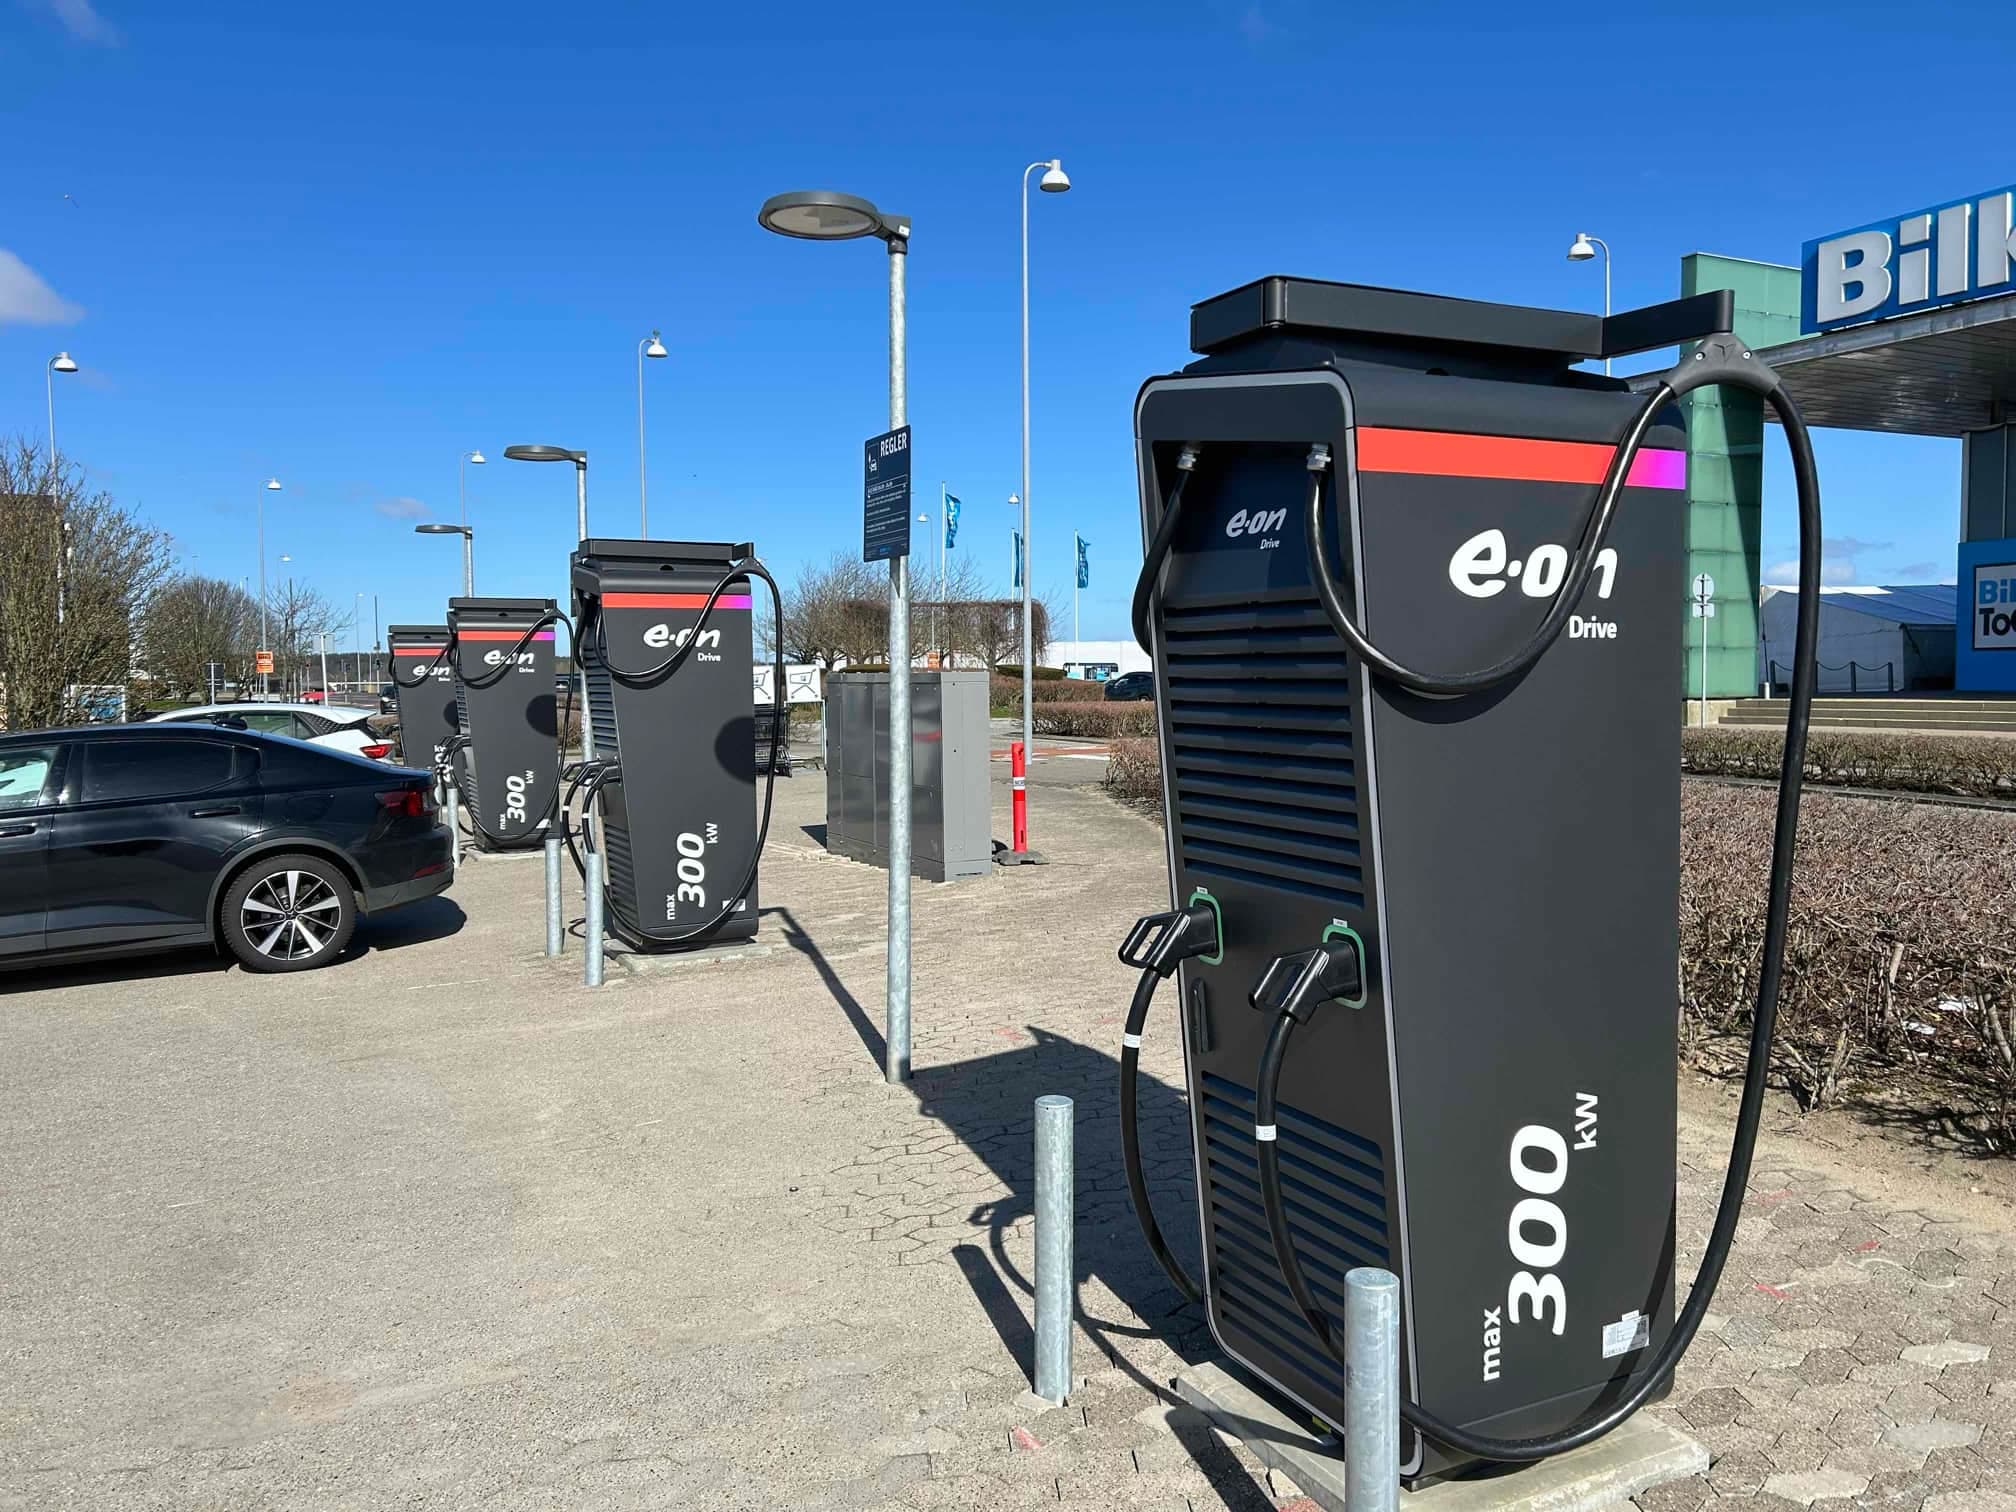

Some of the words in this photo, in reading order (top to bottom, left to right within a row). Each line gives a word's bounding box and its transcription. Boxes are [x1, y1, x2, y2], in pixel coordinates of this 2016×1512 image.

[880, 432, 907, 457] REGLER
[1260, 538, 1280, 549] Drive
[1569, 615, 1618, 638] Drive
[697, 652, 721, 661] Drive
[506, 775, 526, 823] 300
[666, 894, 676, 920] max
[676, 832, 705, 908] 300
[706, 822, 718, 844] kW
[1483, 1305, 1501, 1382] max
[1508, 1124, 1569, 1336] 300
[1574, 1092, 1599, 1150] kW
